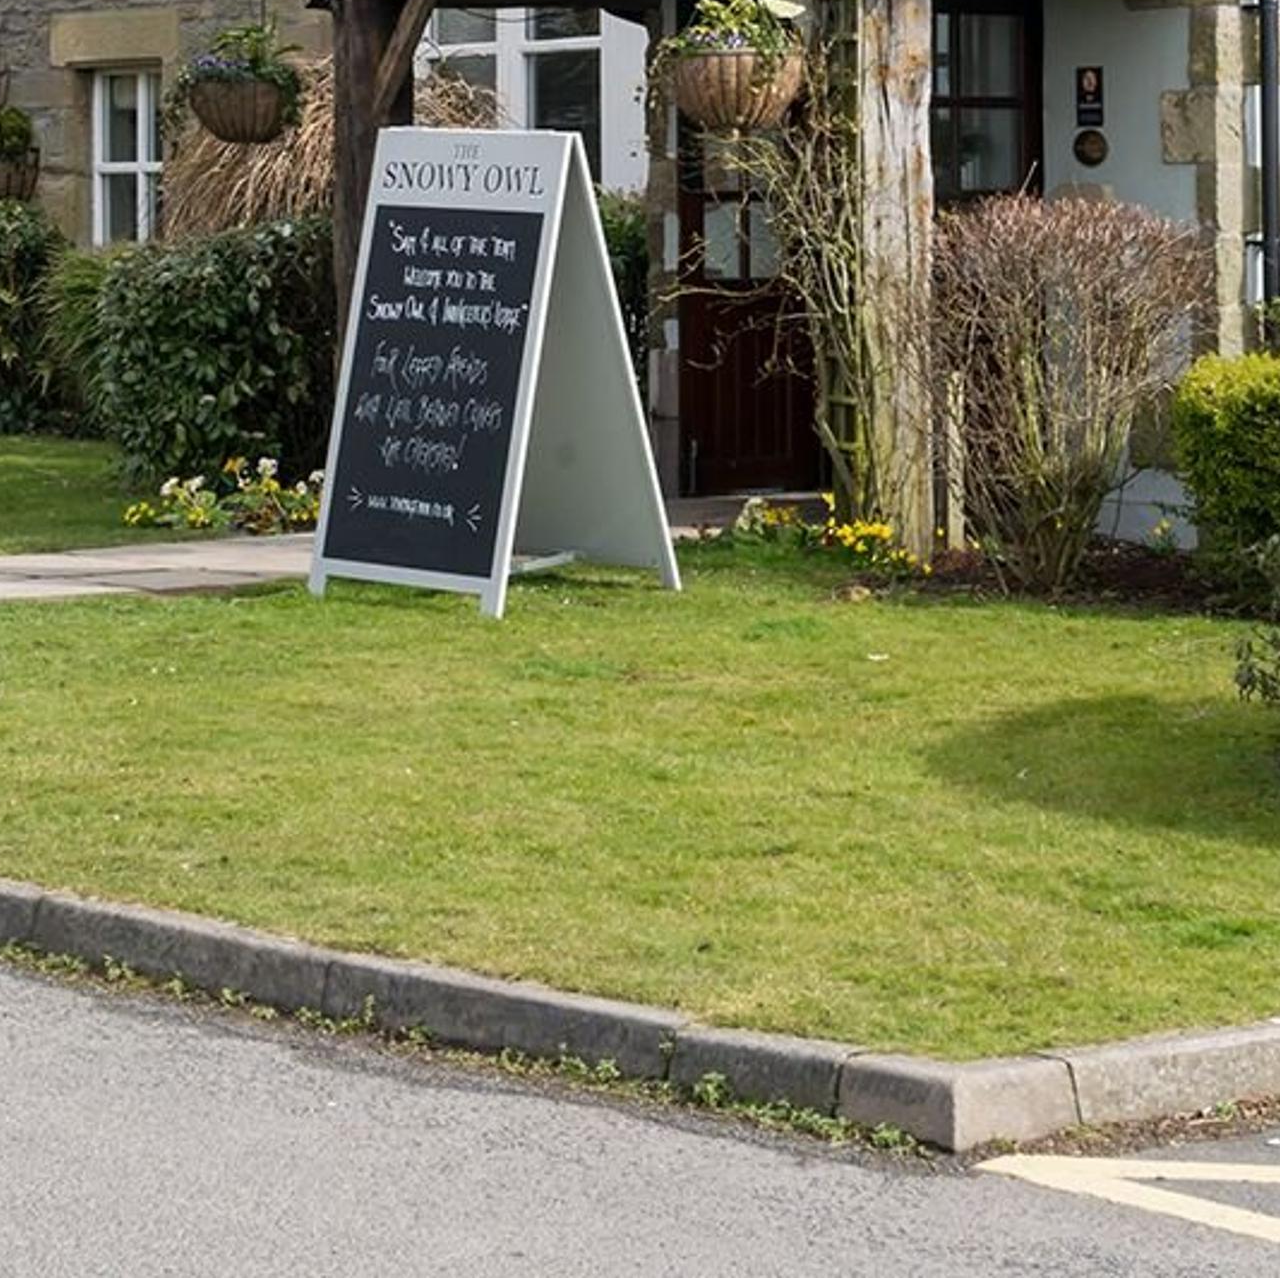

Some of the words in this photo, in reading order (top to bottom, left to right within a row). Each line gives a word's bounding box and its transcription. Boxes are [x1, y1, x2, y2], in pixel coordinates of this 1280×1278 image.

[454, 144, 481, 159] THE
[382, 161, 478, 192] SNOWY
[483, 163, 545, 196] OWL
